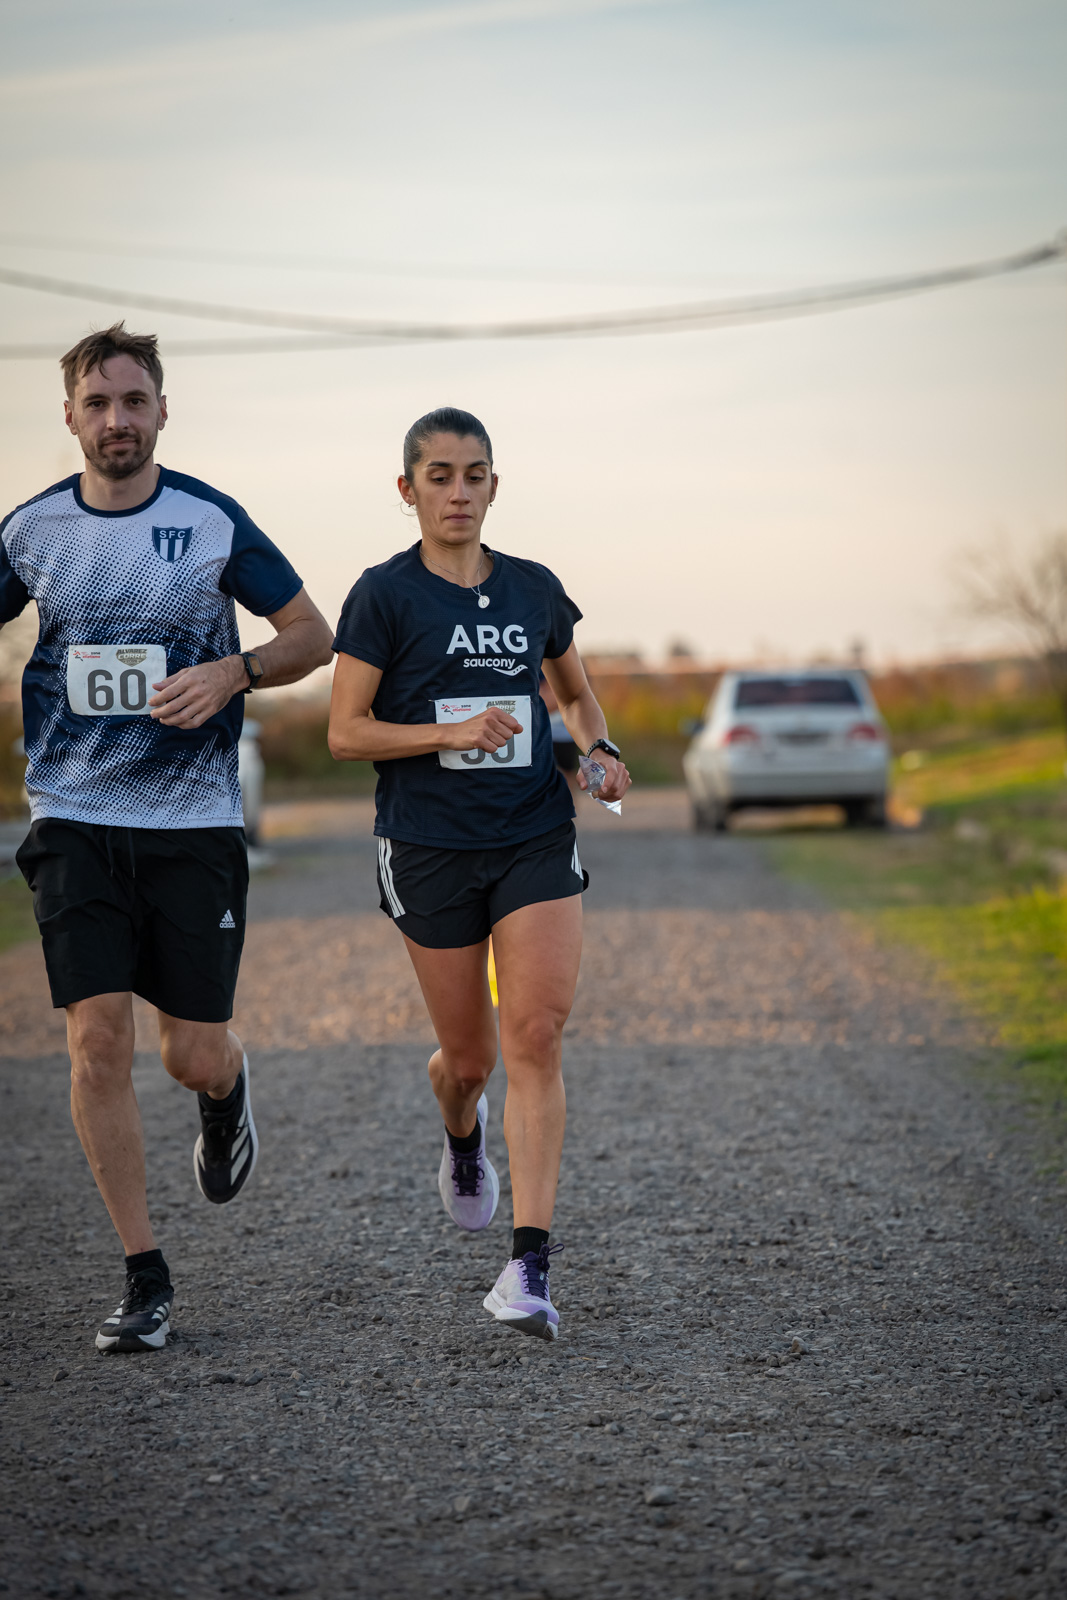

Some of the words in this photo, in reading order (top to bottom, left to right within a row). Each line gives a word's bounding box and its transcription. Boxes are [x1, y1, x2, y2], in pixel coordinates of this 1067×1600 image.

[159, 530, 186, 539] SFC
[446, 624, 529, 655] ARG
[463, 658, 516, 670] saucony
[87, 668, 147, 712] 60
[219, 921, 236, 929] adidas
